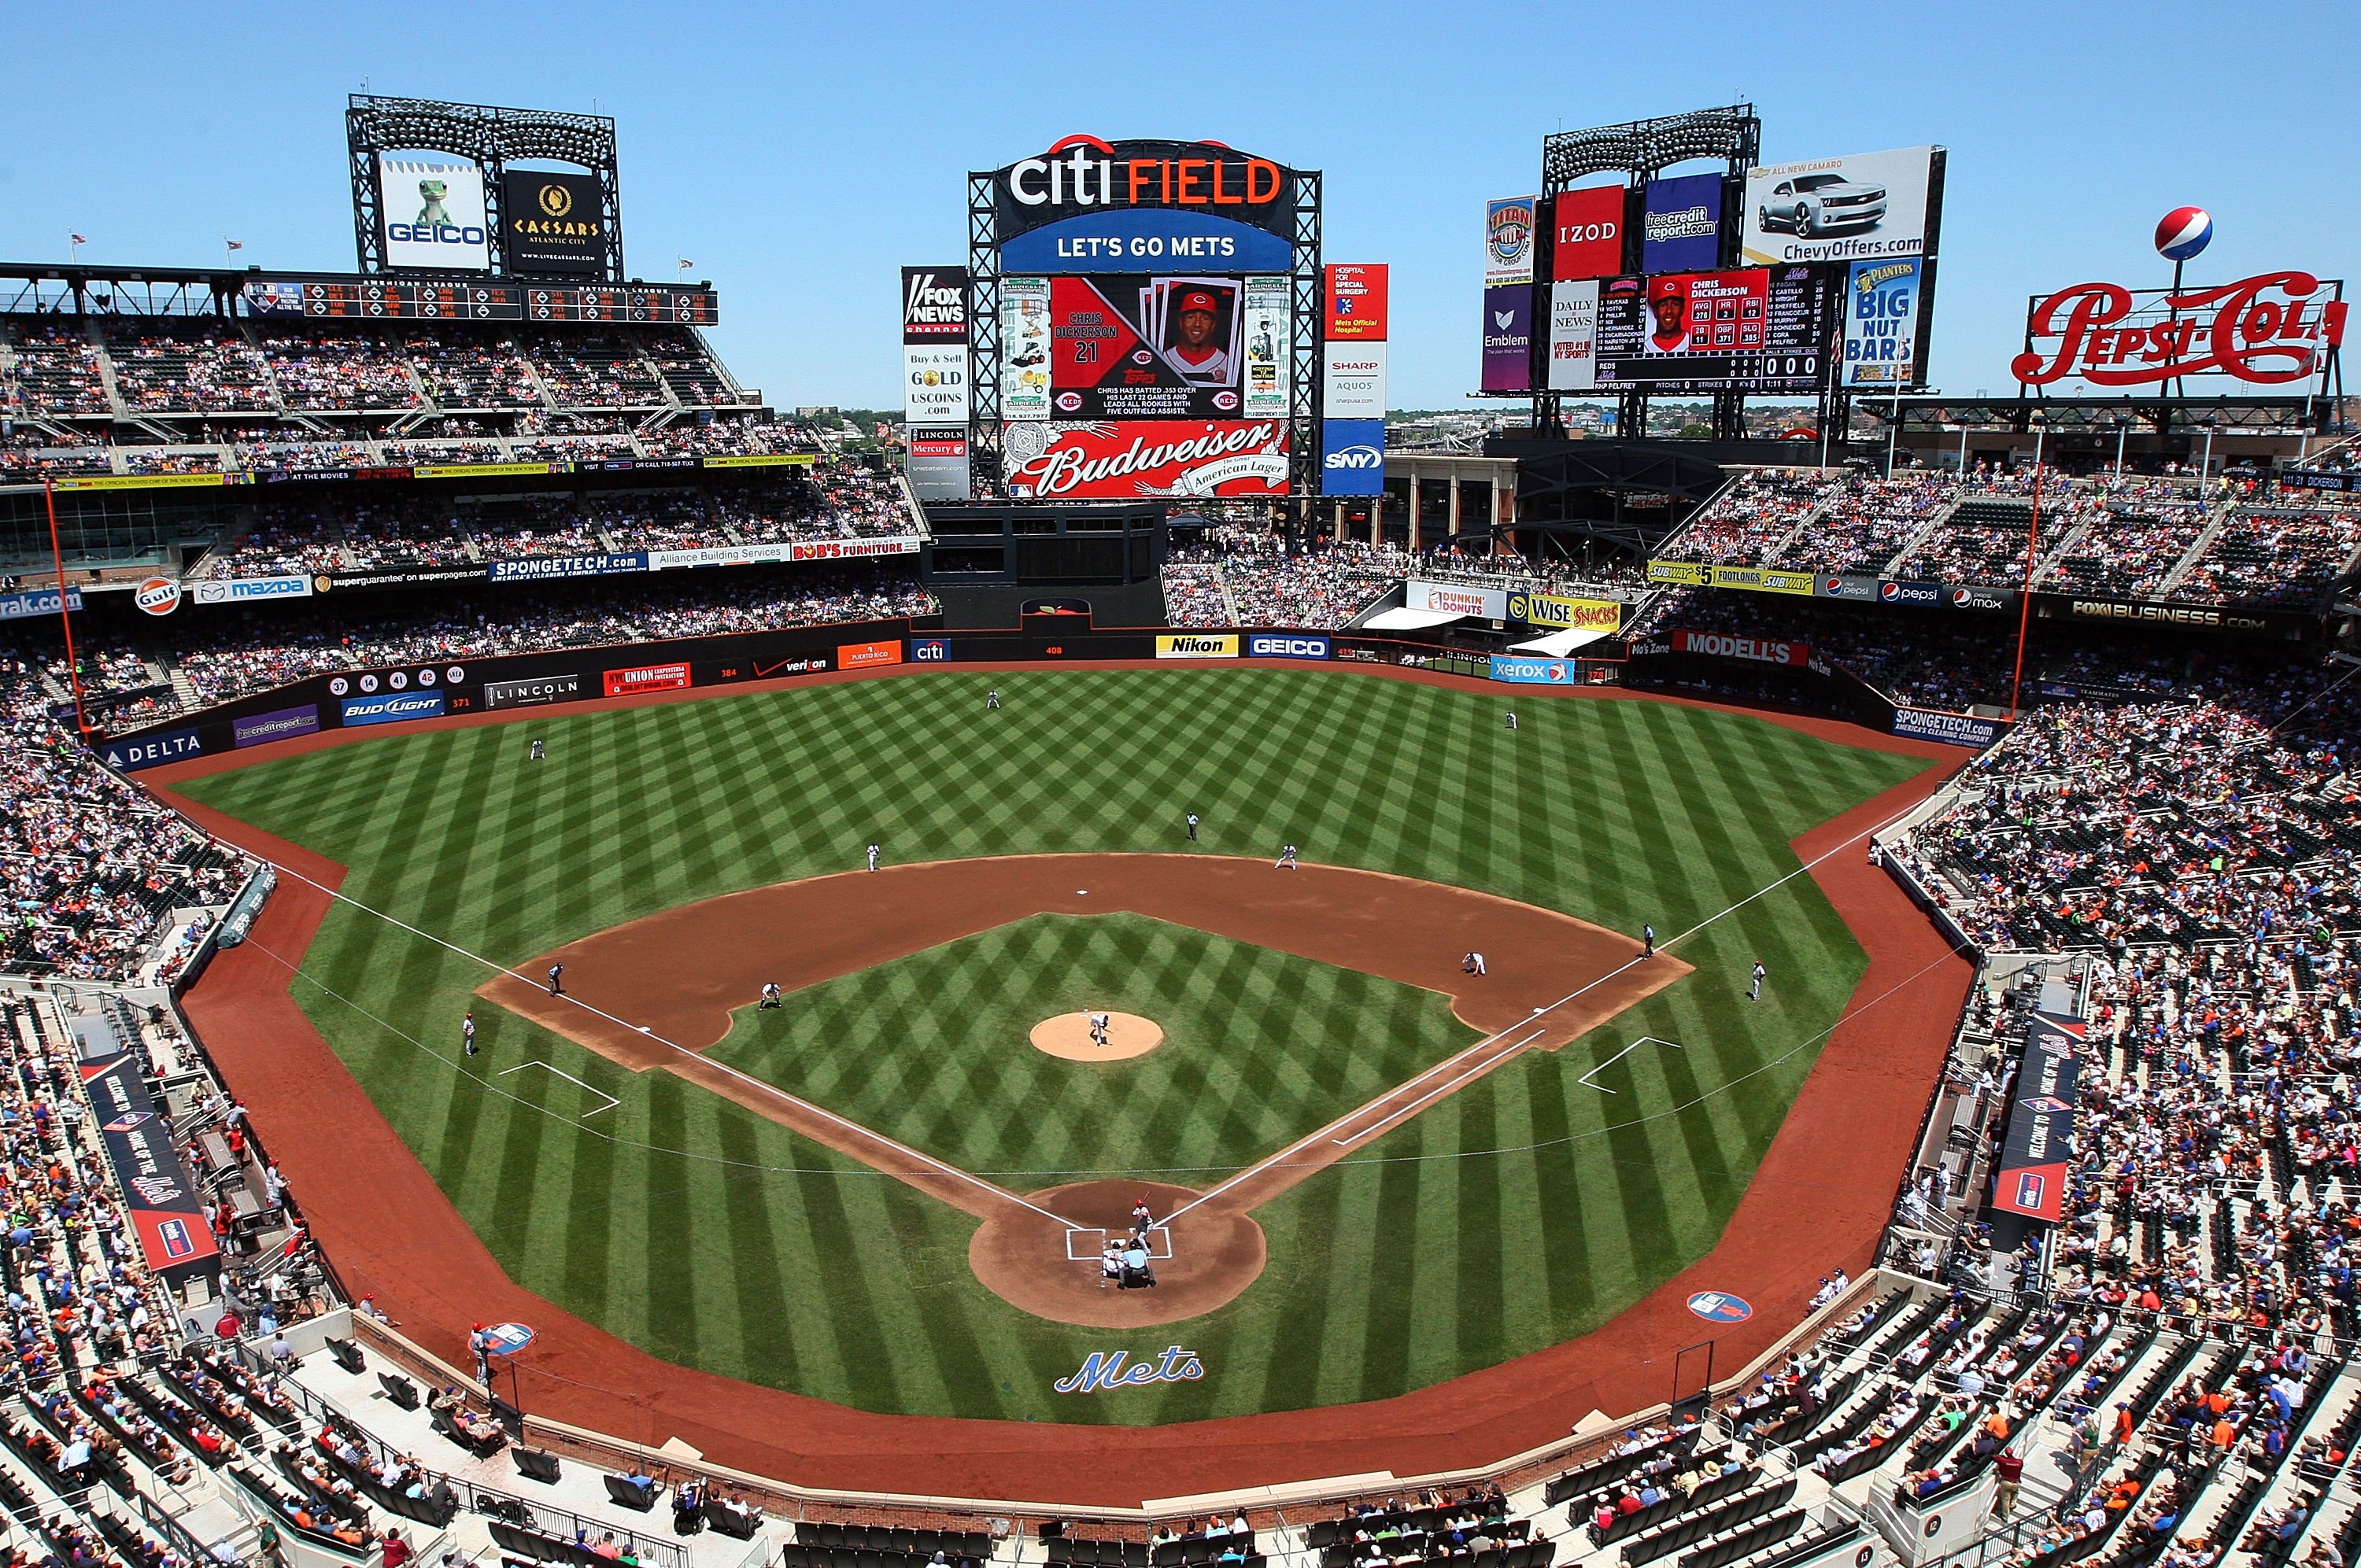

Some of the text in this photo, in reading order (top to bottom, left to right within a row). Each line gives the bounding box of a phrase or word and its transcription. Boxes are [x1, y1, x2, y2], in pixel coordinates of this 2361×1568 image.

[1788, 165, 1806, 174] NEW
[1808, 160, 1842, 171] CAMARO
[1010, 147, 1281, 205] citi FIELD
[1491, 206, 1531, 229] TITAN
[1647, 208, 1705, 226] freecredit
[388, 223, 485, 245] GEICO
[514, 219, 598, 237] CAESARS
[1560, 223, 1616, 243] IZOD
[1058, 237, 1236, 256] LET'S GO METS
[1783, 238, 1922, 261] ChevyOffers.com
[1871, 264, 1913, 282] PLANTERS
[1691, 287, 1748, 298] DICKERSON
[1692, 280, 1719, 290] CHRIS
[924, 288, 963, 305] FOX
[1856, 288, 1909, 319] BIG
[1555, 300, 1593, 312] DAILY
[912, 307, 964, 323] NEWS
[1069, 312, 1103, 324] CHRIS
[1555, 316, 1593, 328] NEWS
[1055, 325, 1118, 338] DICKERSON
[1335, 326, 1363, 334] Hospital
[1863, 319, 1901, 338] NUT
[1485, 334, 1528, 347] Emblem
[1074, 340, 1097, 363] 21
[1565, 349, 1590, 359] SPORTS
[1846, 338, 1911, 361] BARS
[911, 354, 962, 368] Buy & Sell
[1767, 358, 1777, 374] 0
[1786, 357, 1797, 374] 0
[1805, 357, 1816, 374] 0
[911, 393, 962, 404] USCOINS
[925, 405, 950, 415] .com
[912, 445, 951, 455] Mercury
[1022, 422, 1273, 496] Budweiser
[1325, 453, 1373, 469] SNY
[1195, 462, 1284, 488] American Lager
[2283, 475, 2293, 485] 1:11
[2296, 477, 2304, 485] 21
[2307, 477, 2343, 489] DICKERSON
[660, 547, 781, 564] Alliance Building Services
[793, 543, 841, 560] BOB'S
[843, 543, 903, 556] FURNITURE
[496, 555, 637, 576] SPONGETECH.com
[419, 569, 487, 584] superpages.com
[1650, 566, 1813, 590] SUBWAY $5 FOOTLONGS SUBWAY
[139, 586, 177, 606] Gulf
[231, 579, 305, 597] mazda
[1844, 587, 1868, 596] pepsi
[1901, 589, 1937, 601] pepsi
[1443, 592, 1485, 606] DUNKIN'
[1972, 599, 2002, 610] max
[1443, 602, 1483, 615] DONUTS
[2072, 600, 2112, 618] FOX
[917, 642, 943, 660] citi
[1170, 637, 1224, 653] Nikon
[1253, 639, 1325, 656] GEICO
[1631, 642, 1670, 655] Mo's Zone
[1687, 633, 1790, 664] MODELL'S
[721, 669, 737, 677] 384
[787, 659, 826, 672] verizon
[1496, 662, 1544, 677] xerox
[364, 678, 374, 688] 14
[393, 676, 403, 685] 41
[421, 673, 433, 682] 42
[334, 682, 345, 691] 37
[497, 681, 578, 699] LINCOLN
[2080, 688, 2120, 699] TEAMMATES
[345, 699, 441, 718] BUD LIGHT
[453, 698, 470, 708] 371
[1896, 710, 1993, 736] SPONGETECH.com
[1895, 723, 1927, 734] AMERICA'S
[1927, 728, 1958, 738] CLEANING
[1959, 732, 1990, 743] COMPANY
[129, 735, 201, 763] DELTA
[2038, 1034, 2075, 1060] Mets
[2040, 1056, 2060, 1095] HOME OF THE
[105, 1075, 126, 1101] WELCOME
[115, 1100, 131, 1112] TO
[2028, 1115, 2050, 1159] WELCOME TO
[127, 1131, 157, 1175] HOME OF THE
[131, 1176, 183, 1206] Mets
[2023, 1176, 2039, 1207] mets.com
[163, 1223, 185, 1255] mets.com
[1054, 1345, 1204, 1393] Mets
[1930, 1520, 1938, 1530] 12
[1860, 1551, 1868, 1562] 13
